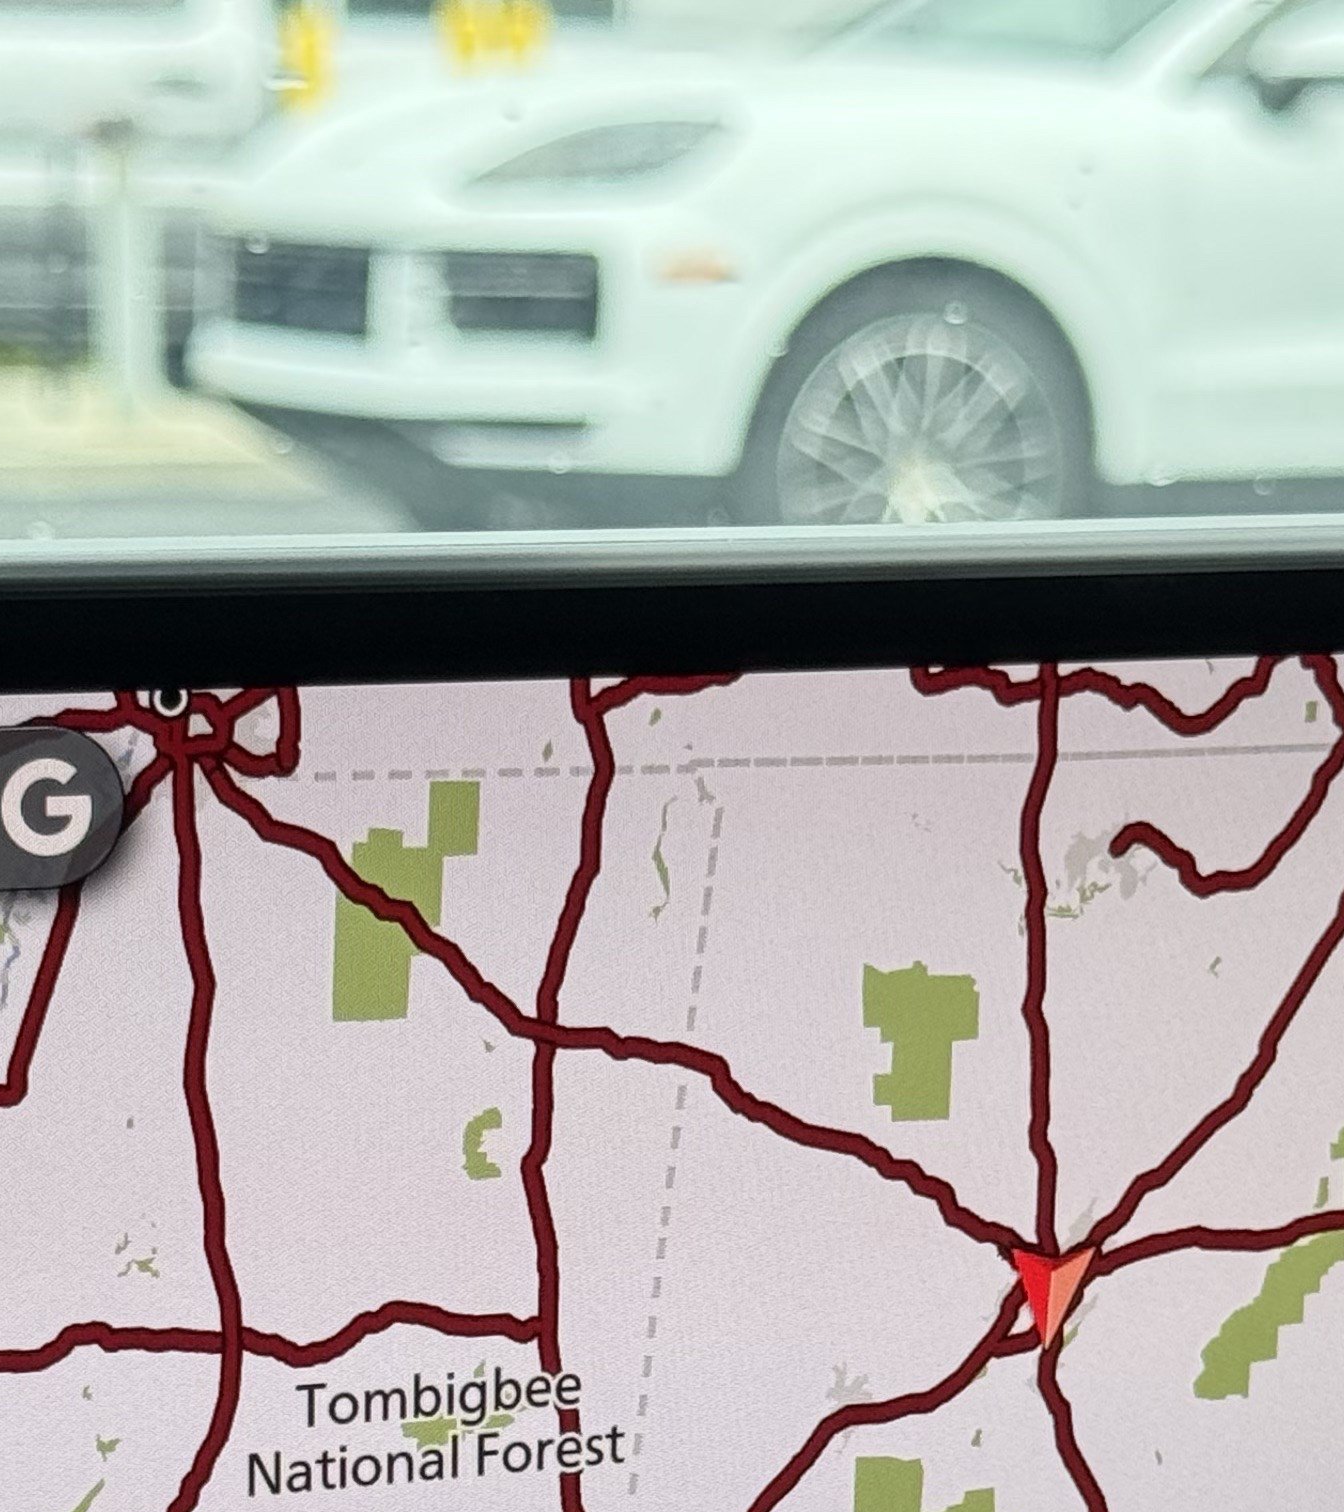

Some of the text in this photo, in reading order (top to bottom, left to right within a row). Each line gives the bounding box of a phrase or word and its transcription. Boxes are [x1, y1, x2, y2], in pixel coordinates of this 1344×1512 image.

[0, 757, 93, 857] G
[295, 1366, 582, 1427] Tombigbee
[248, 1425, 626, 1498] National Forest
